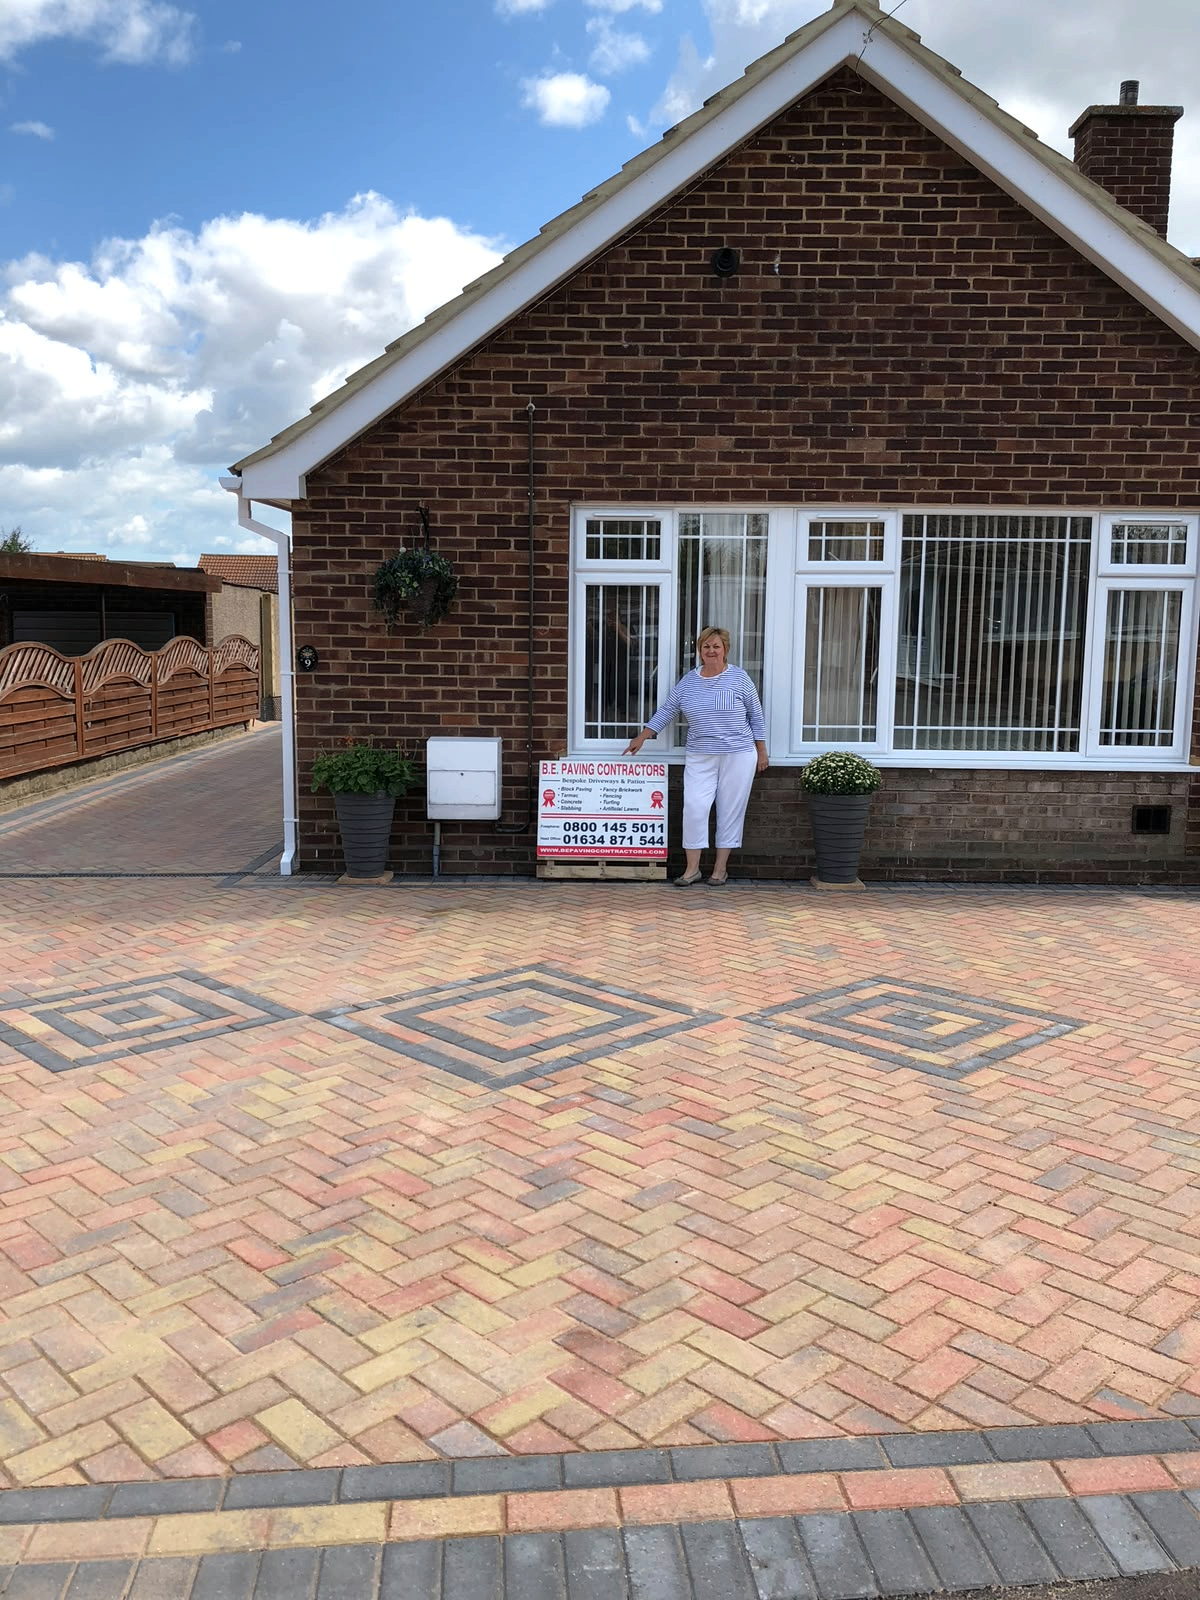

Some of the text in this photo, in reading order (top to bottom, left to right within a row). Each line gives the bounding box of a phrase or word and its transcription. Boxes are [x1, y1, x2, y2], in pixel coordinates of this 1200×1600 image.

[304, 658, 311, 667] 9
[541, 763, 665, 776] B.E. PAVING CONTRACTORS
[563, 822, 597, 832] 0800
[602, 822, 627, 832] 145
[631, 823, 664, 834] 5011
[563, 834, 605, 845] 01634
[609, 836, 634, 846] 871
[639, 836, 665, 846] 544
